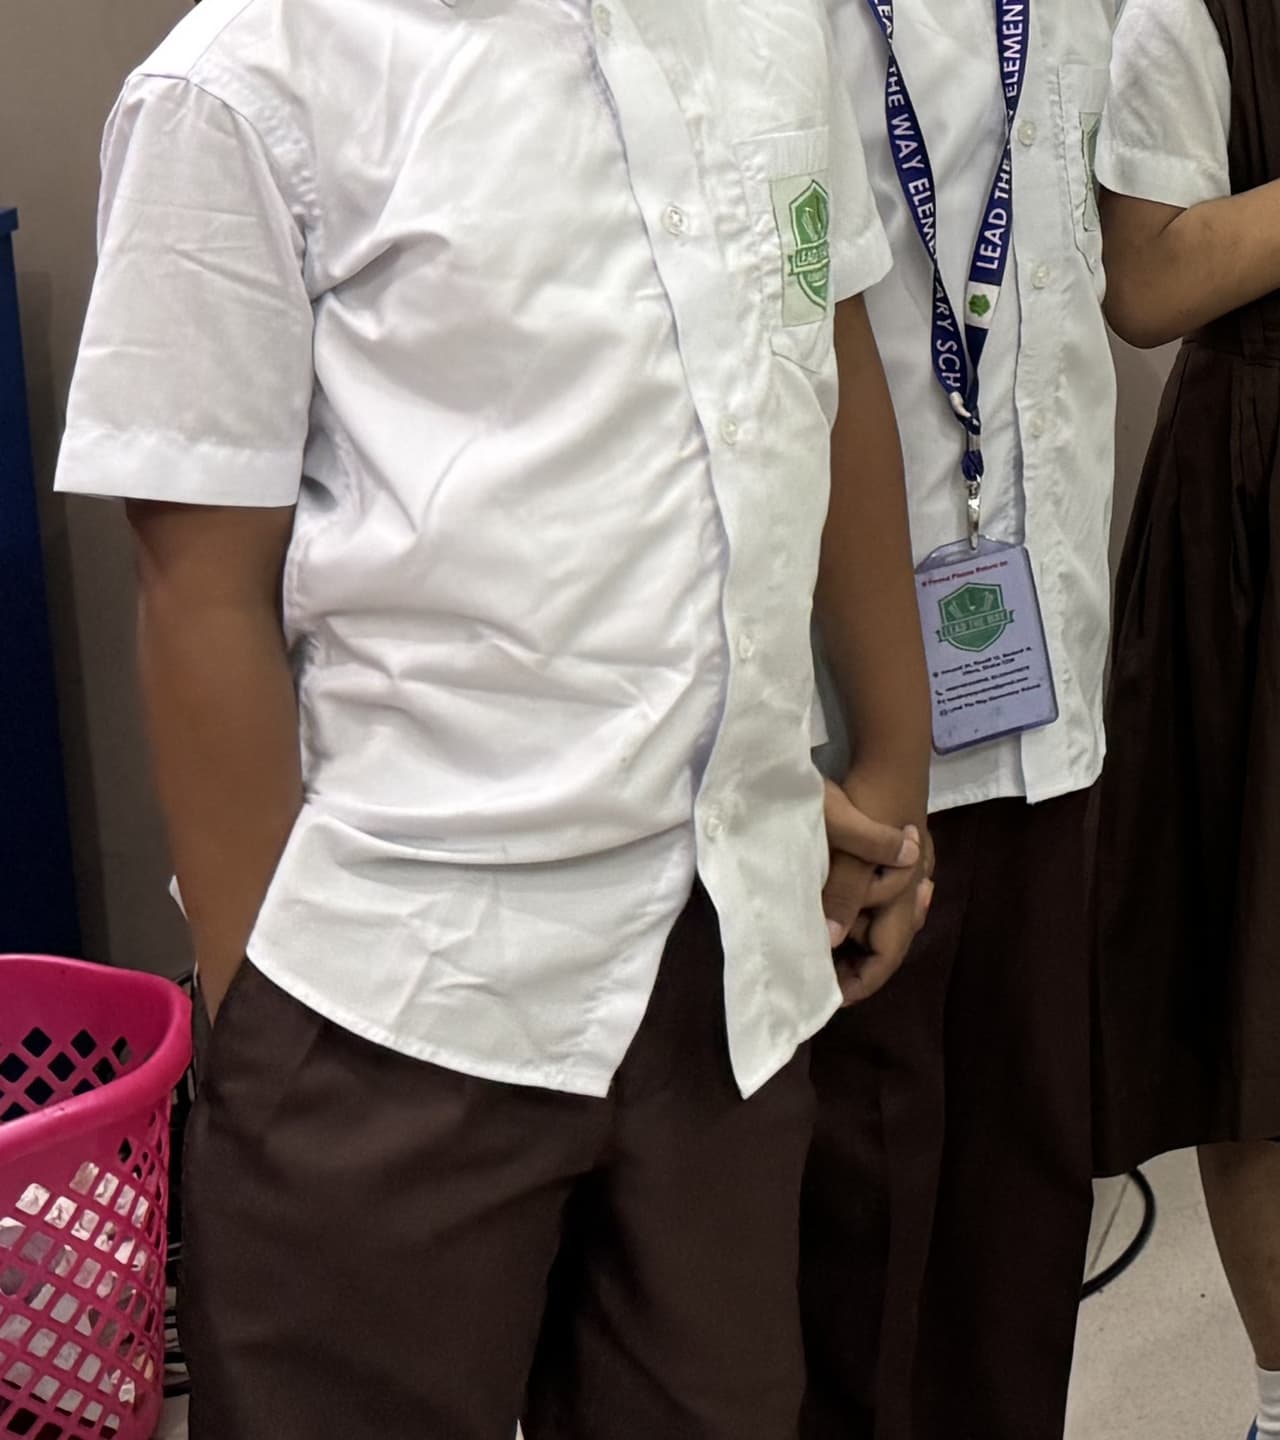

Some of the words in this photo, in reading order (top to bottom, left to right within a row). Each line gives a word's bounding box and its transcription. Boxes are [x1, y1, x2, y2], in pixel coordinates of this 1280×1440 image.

[888, 64, 905, 108] THE
[891, 113, 925, 169] WAY
[976, 209, 1008, 270] LEAD
